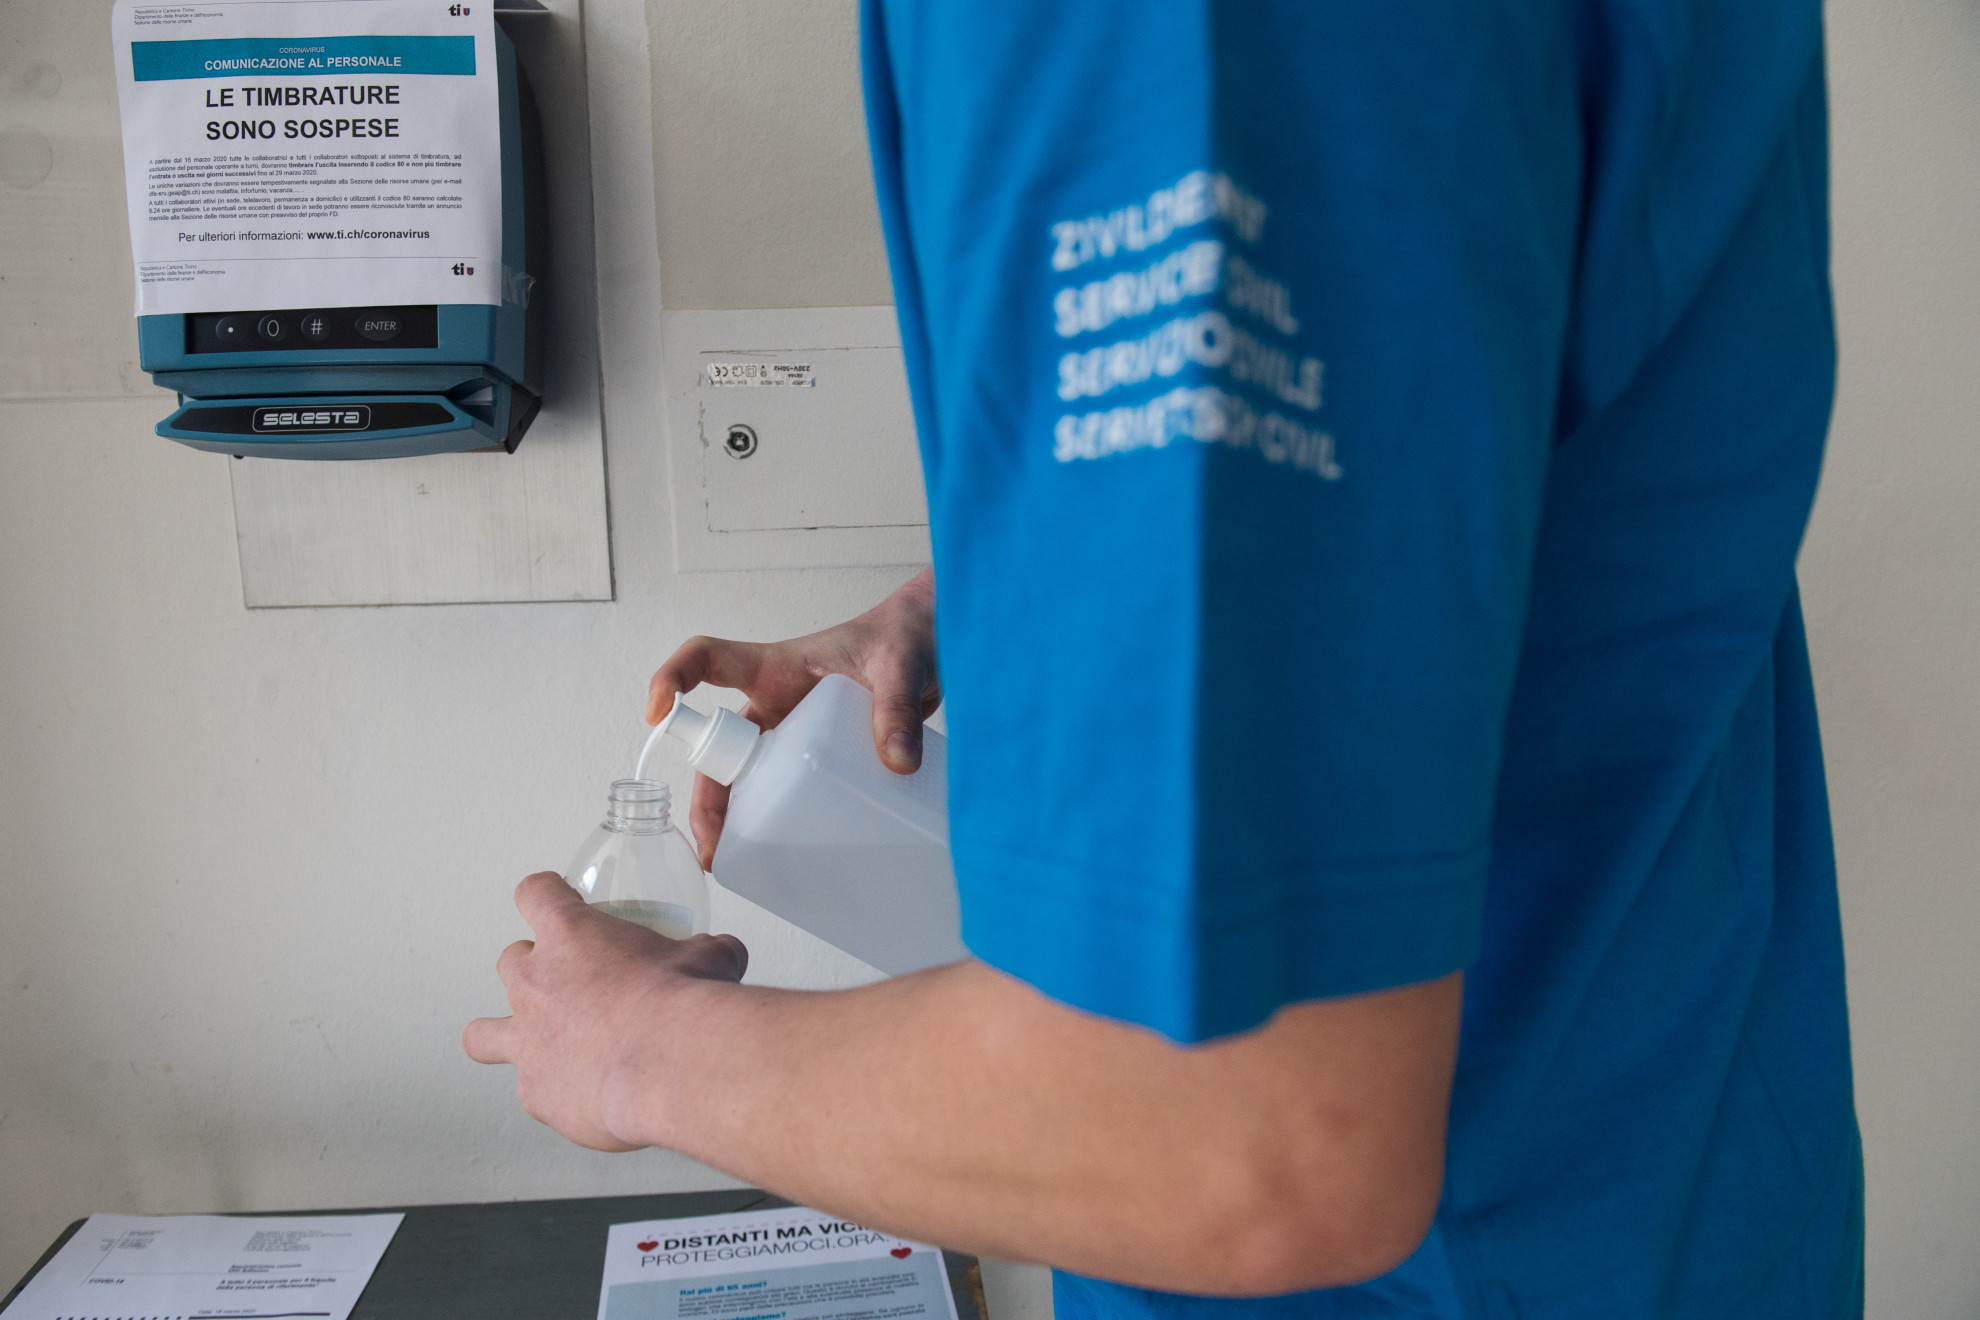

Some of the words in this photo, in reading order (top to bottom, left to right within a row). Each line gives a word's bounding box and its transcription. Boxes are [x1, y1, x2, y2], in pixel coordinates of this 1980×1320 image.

[448, 4, 461, 16] ti
[204, 58, 305, 71] COMUNICAZIONE
[308, 57, 324, 68] AL
[327, 56, 402, 67] PERSONALE
[206, 88, 234, 108] LE
[242, 85, 400, 107] TIMBRATURE
[206, 120, 276, 140] SONO
[283, 118, 400, 139] SOSPESE
[154, 157, 171, 166] partire
[251, 153, 287, 161] collaboratrici
[350, 153, 378, 161] sottoposti
[420, 153, 451, 161] timbratura,
[149, 164, 176, 172] esclusione
[186, 163, 213, 172] personale
[214, 162, 239, 171] operante
[245, 162, 260, 170] turni,
[424, 160, 434, 169] più
[148, 172, 171, 180] l'entrata
[206, 170, 224, 179] giorni
[224, 169, 256, 177] successivi
[156, 181, 174, 189] uniche
[175, 180, 201, 188] variazioni
[213, 179, 239, 187] dovranno
[260, 178, 308, 187] tempestivamente
[309, 177, 337, 186] segnalate
[430, 177, 442, 185] (per
[215, 187, 239, 196] malattia,
[240, 186, 268, 195] infortunio,
[171, 205, 202, 214] giornaliere.
[323, 202, 349, 211] potranno
[370, 201, 405, 209] riconosciute
[148, 213, 169, 221] mensile
[180, 212, 203, 220] Sezione
[270, 211, 298, 219] preavviso
[308, 210, 328, 219] proprio
[178, 232, 196, 242] Per
[198, 231, 236, 242] ulteriori
[239, 231, 304, 241] informazioni:
[307, 229, 430, 240] www.ti.ch/coronavirus
[451, 263, 464, 275] ti
[364, 320, 396, 331] ENTER
[664, 1230, 768, 1250] DISTANTI
[777, 1225, 812, 1240] MA
[818, 1223, 869, 1234] VIC
